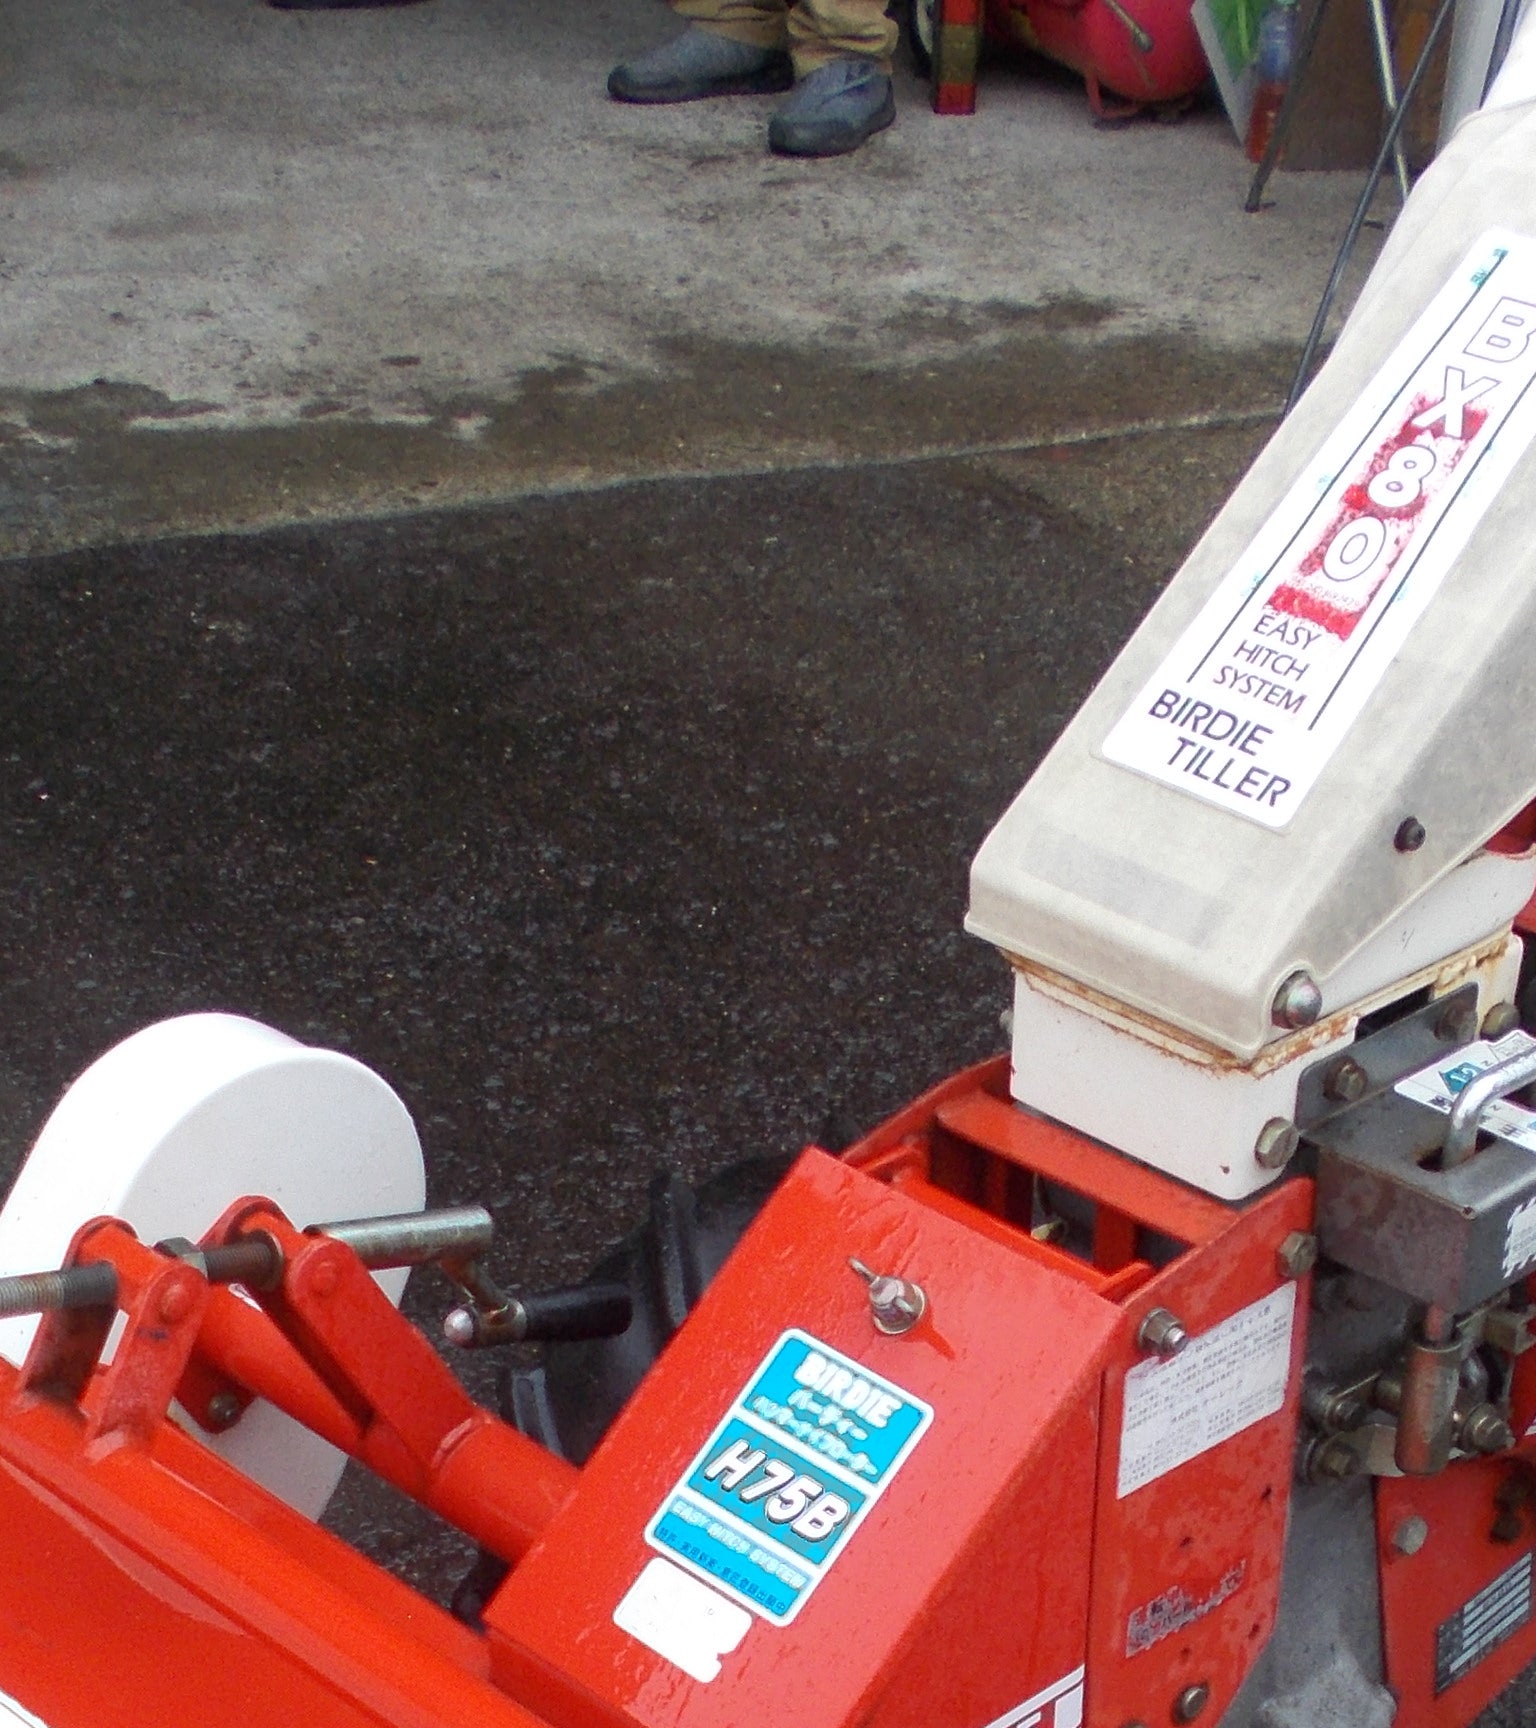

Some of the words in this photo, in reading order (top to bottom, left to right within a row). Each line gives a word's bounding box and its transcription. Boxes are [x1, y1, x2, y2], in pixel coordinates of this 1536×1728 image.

[1233, 639, 1310, 682] HITCH
[1253, 614, 1321, 651] EASY
[1148, 688, 1274, 757] BIRDIE
[1213, 665, 1307, 714] SYSTEM
[1167, 736, 1291, 807] TILLER
[793, 1350, 902, 1428] BIRDIE
[704, 1438, 851, 1542] H75B
